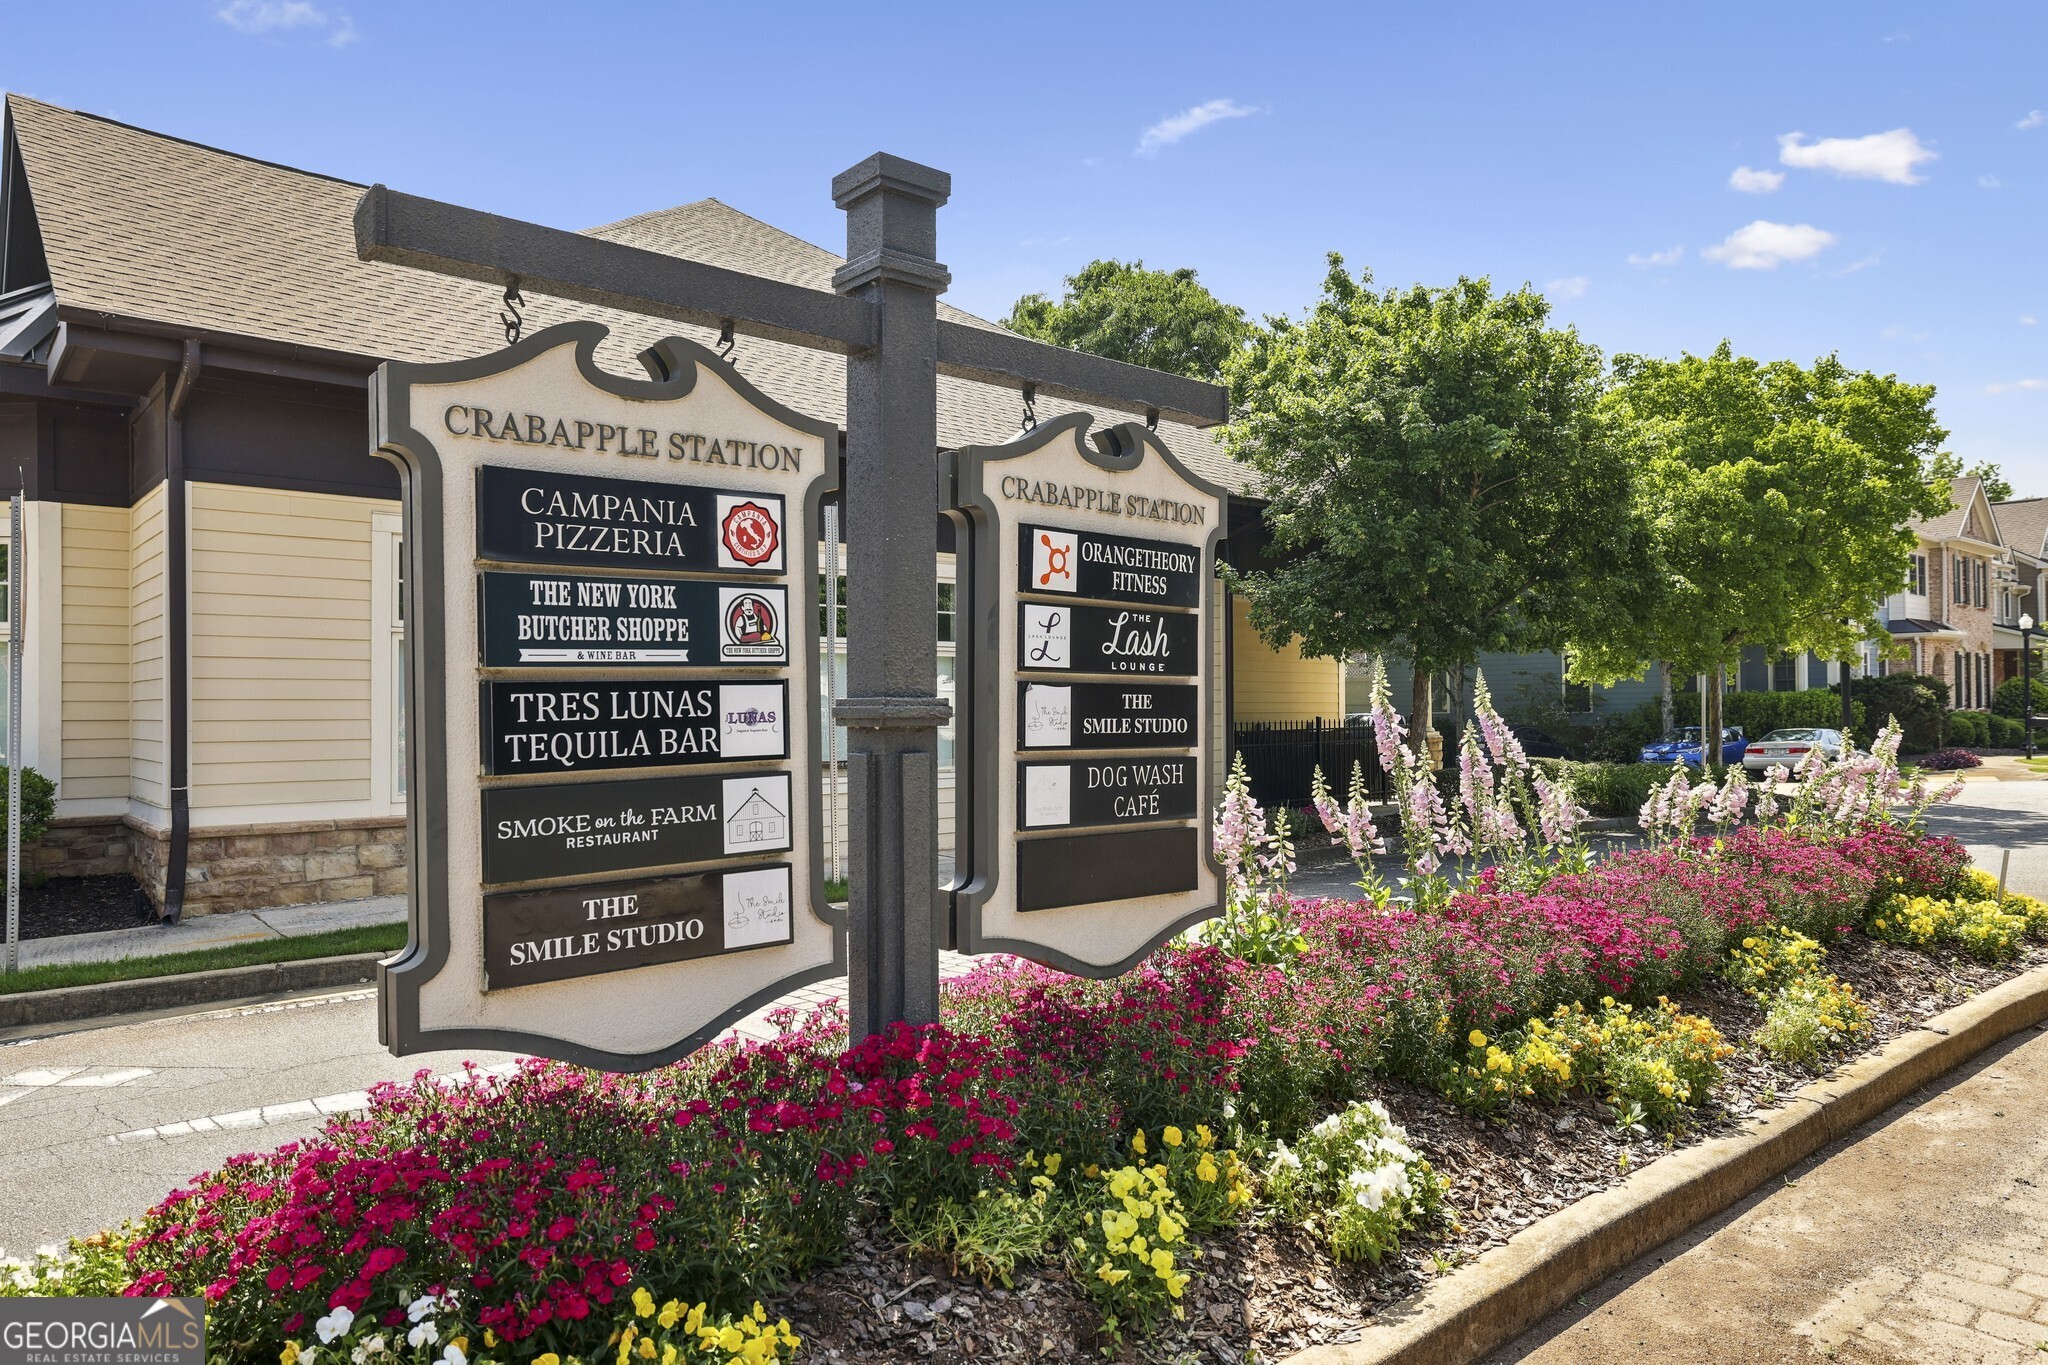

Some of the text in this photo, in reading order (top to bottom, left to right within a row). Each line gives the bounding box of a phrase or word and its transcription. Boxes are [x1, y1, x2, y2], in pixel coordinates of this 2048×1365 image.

[444, 405, 802, 473] CRABAPPLE STATION
[520, 487, 697, 527] CAMPANIA
[1001, 476, 1206, 525] CRABAPPLE STATION
[535, 522, 686, 558] PIZZERIA
[1082, 542, 1196, 574] ORANGETHEORY
[530, 581, 678, 609] THE NEW YORK
[1113, 571, 1167, 596] FITNESS
[518, 615, 689, 642] BUTCHER SHOPPE
[1132, 614, 1151, 623] THE
[1102, 612, 1170, 657] Lash
[577, 651, 636, 660] & WINE BAR
[1112, 661, 1165, 672] LOUNGE
[510, 690, 712, 722] TRES LUNAS
[1122, 694, 1153, 710] THE
[728, 711, 776, 724] LUNAS
[1083, 718, 1188, 734] SMILE STUDIO
[504, 727, 720, 767] TEQUILA BAR
[1088, 764, 1184, 789] DOG WASH
[1114, 789, 1160, 818] CAFÉ
[497, 804, 717, 840] SMOKE on the FARM
[566, 829, 659, 849] RESTAURANT
[583, 895, 638, 921] THE
[510, 918, 704, 967] SMILE STUDIO
